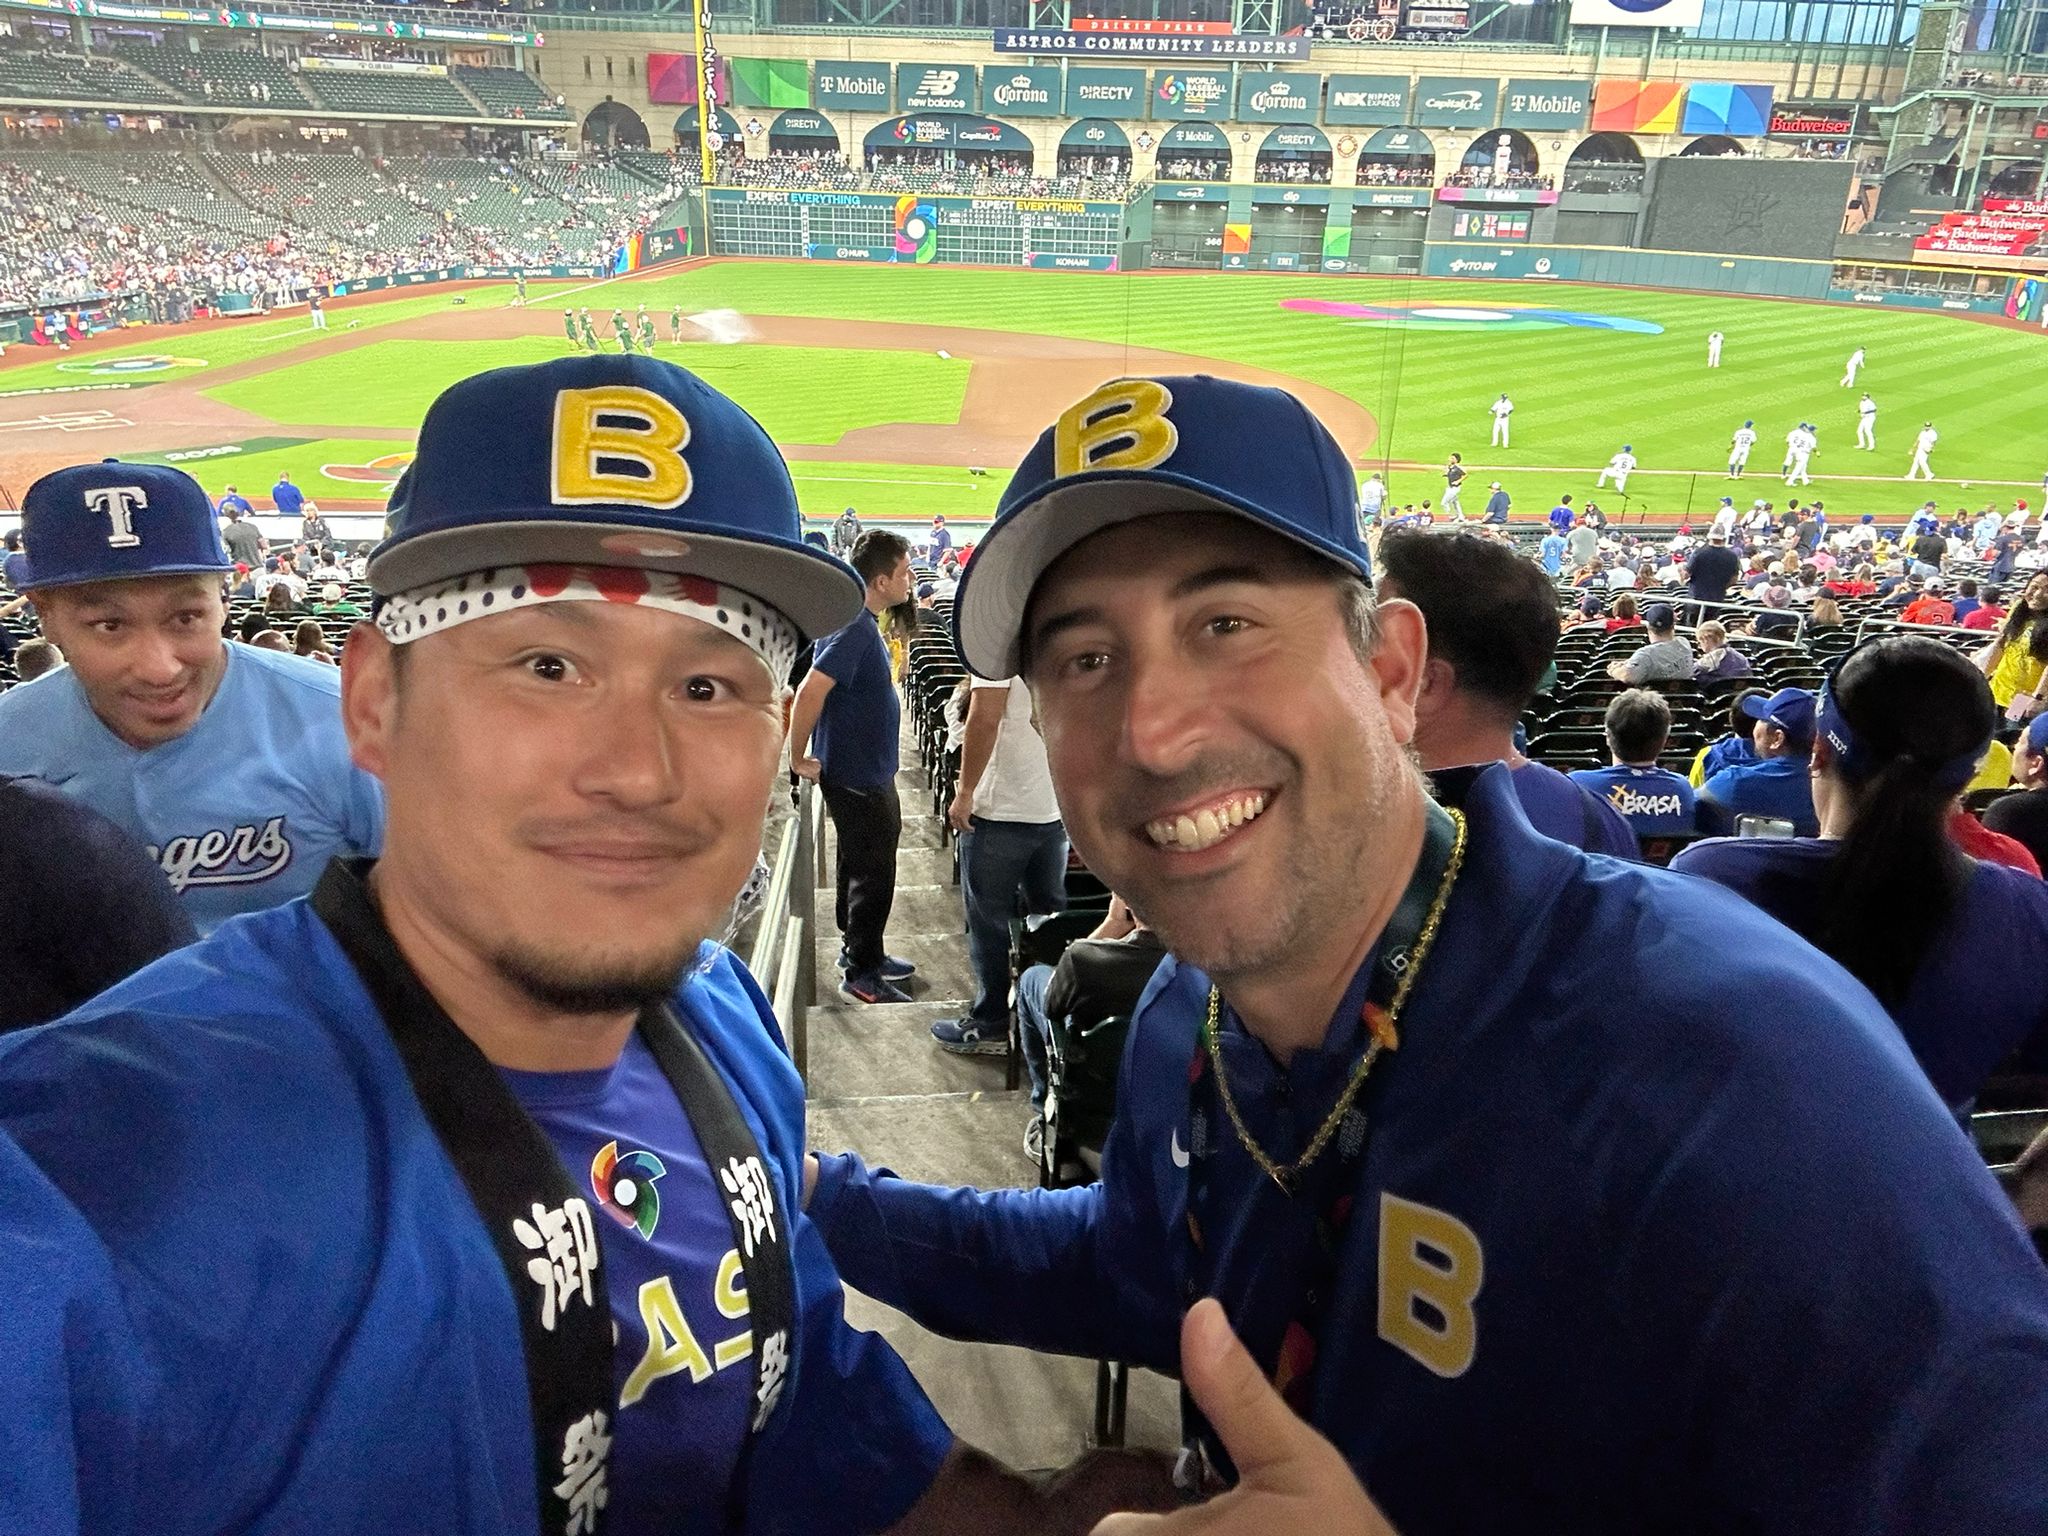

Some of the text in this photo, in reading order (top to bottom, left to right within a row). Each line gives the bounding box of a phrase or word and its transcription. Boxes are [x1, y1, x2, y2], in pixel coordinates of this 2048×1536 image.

[1091, 21, 1206, 32] DAIKIN PARK
[1006, 35, 1298, 54] ASTROS COMMUNITY LEADERS
[836, 77, 886, 95] Mobile
[1186, 77, 1217, 85] WORLD
[705, 68, 719, 131] FAIR
[993, 84, 1048, 106] Corona
[1079, 86, 1133, 100] DIRECTV
[1368, 93, 1401, 101] NIPPON
[907, 97, 965, 108] new balance
[1250, 91, 1307, 113] Corona
[1527, 95, 1582, 114] Mobile
[785, 118, 821, 129] DIRECTV
[1771, 118, 1850, 133] Budweiser
[1086, 127, 1105, 140] dip
[1185, 131, 1214, 142] Mobile
[1277, 134, 1316, 145] DIRECTV
[746, 191, 860, 205] EXPECT EVERYTHING
[972, 199, 1085, 213] EXPECT EVERYTHING
[1979, 217, 2046, 231] Budweiser
[1952, 225, 2017, 242] Budweiser
[1947, 240, 2011, 254] Budweiser
[1055, 257, 1090, 268] KONAMI
[1054, 379, 1179, 480] B
[550, 385, 693, 510] B
[84, 486, 149, 549] T
[148, 816, 291, 894] gers
[1377, 1191, 1484, 1379] B
